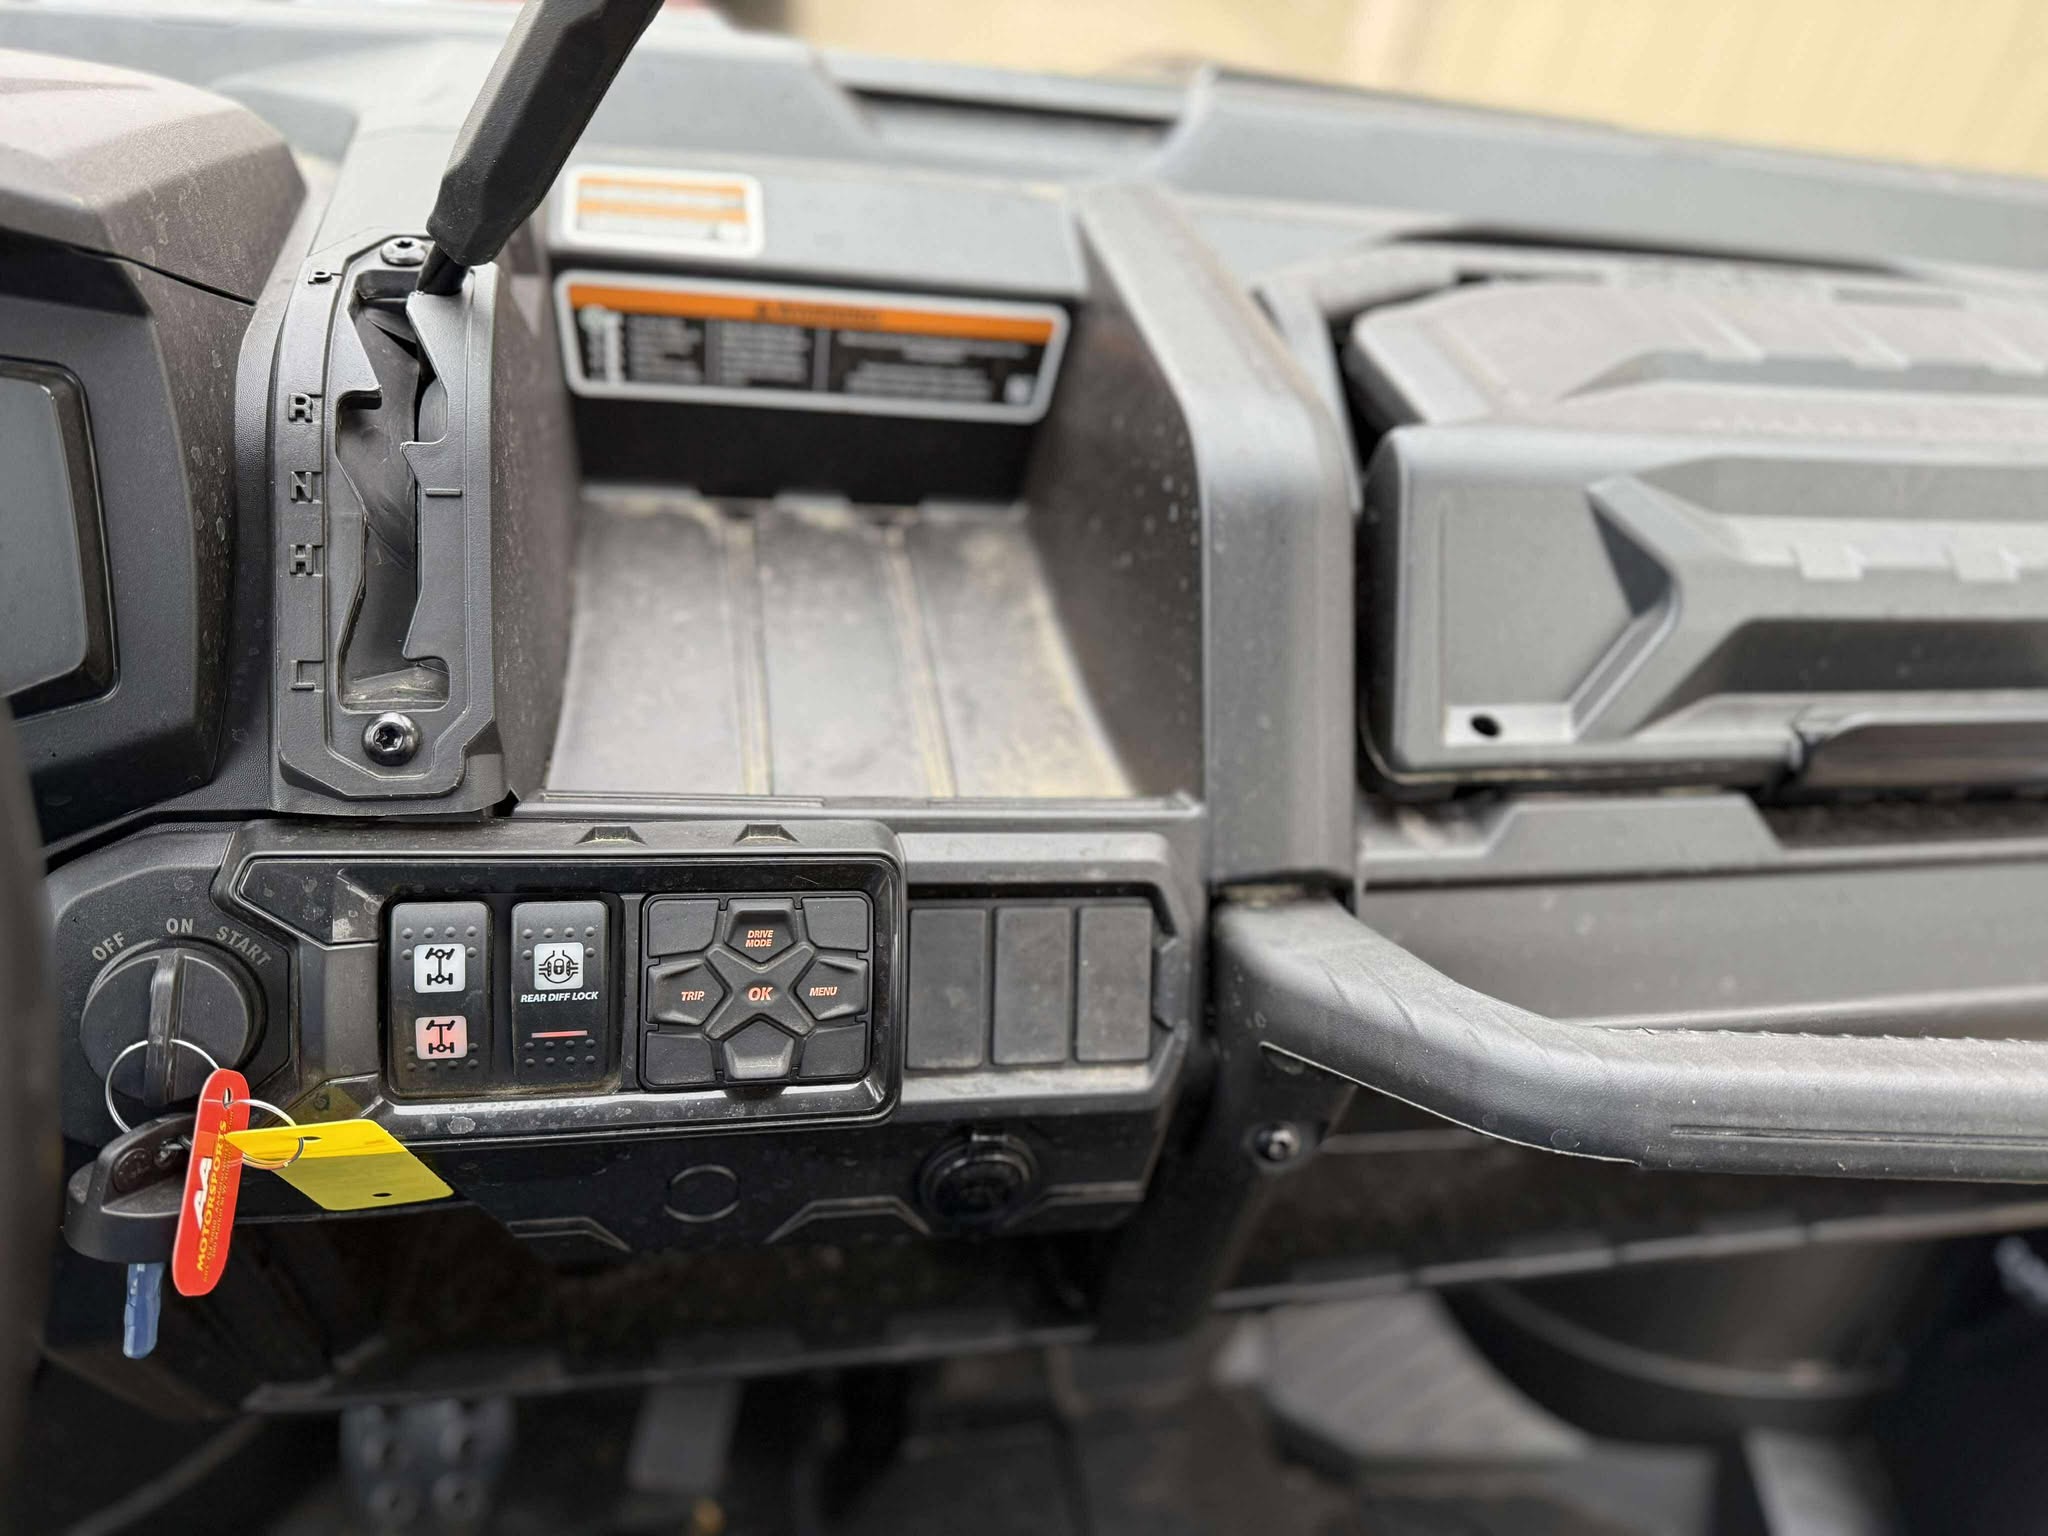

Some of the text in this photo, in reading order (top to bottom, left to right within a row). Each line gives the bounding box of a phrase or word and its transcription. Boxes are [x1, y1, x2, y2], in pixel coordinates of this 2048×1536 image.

[288, 393, 313, 423] R
[290, 471, 313, 502] N
[290, 544, 313, 576] H
[290, 660, 315, 691] L
[166, 918, 194, 935] ON
[747, 930, 774, 939] DRIVE
[92, 931, 125, 961] OFF
[216, 926, 272, 966] START
[745, 939, 772, 948] MODE
[520, 991, 599, 1003] REAR DIFF LOCK
[681, 991, 705, 1001] TRIP
[748, 987, 773, 1001] OK
[809, 986, 837, 997] MENU
[197, 1120, 227, 1271] MOTORSPORTS
